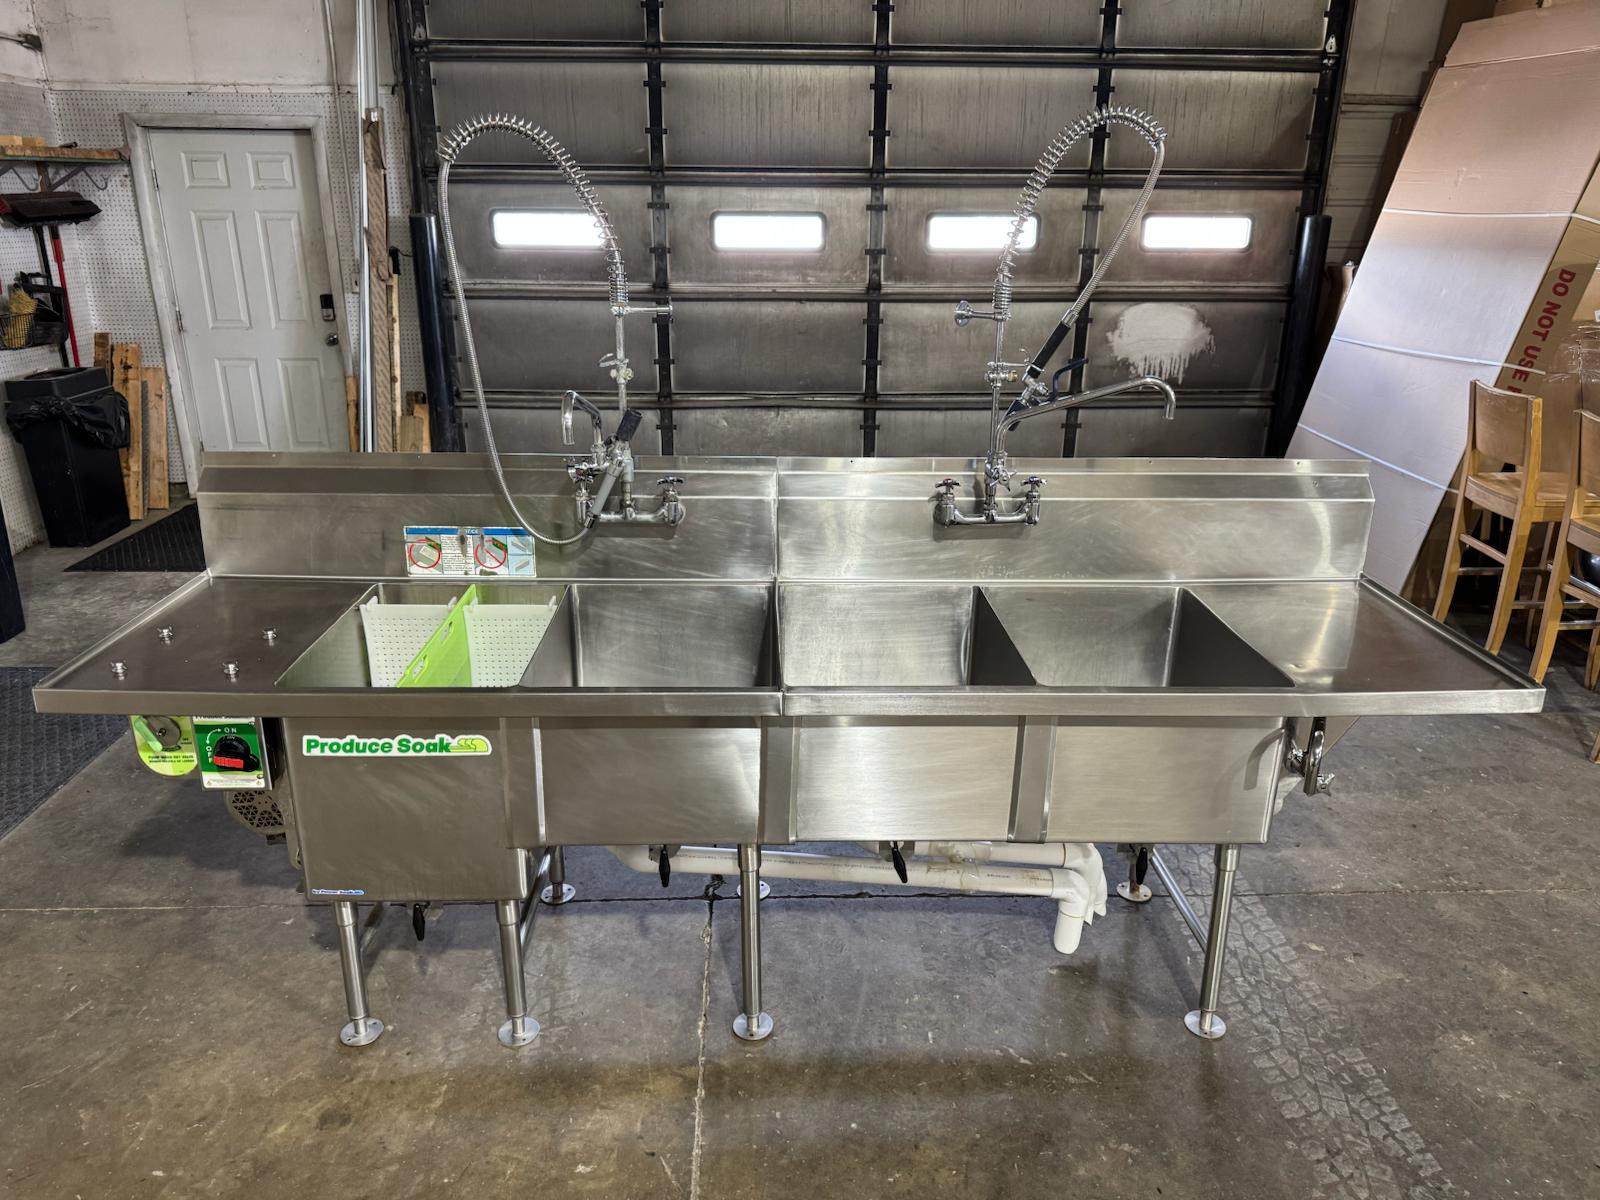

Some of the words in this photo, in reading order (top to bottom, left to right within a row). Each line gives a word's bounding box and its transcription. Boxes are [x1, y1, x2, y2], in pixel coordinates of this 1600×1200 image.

[1552, 269, 1576, 297] DO
[1532, 301, 1562, 341] NOT
[1512, 345, 1542, 382] USE
[306, 738, 393, 753] Produce
[397, 737, 451, 753] Soak
